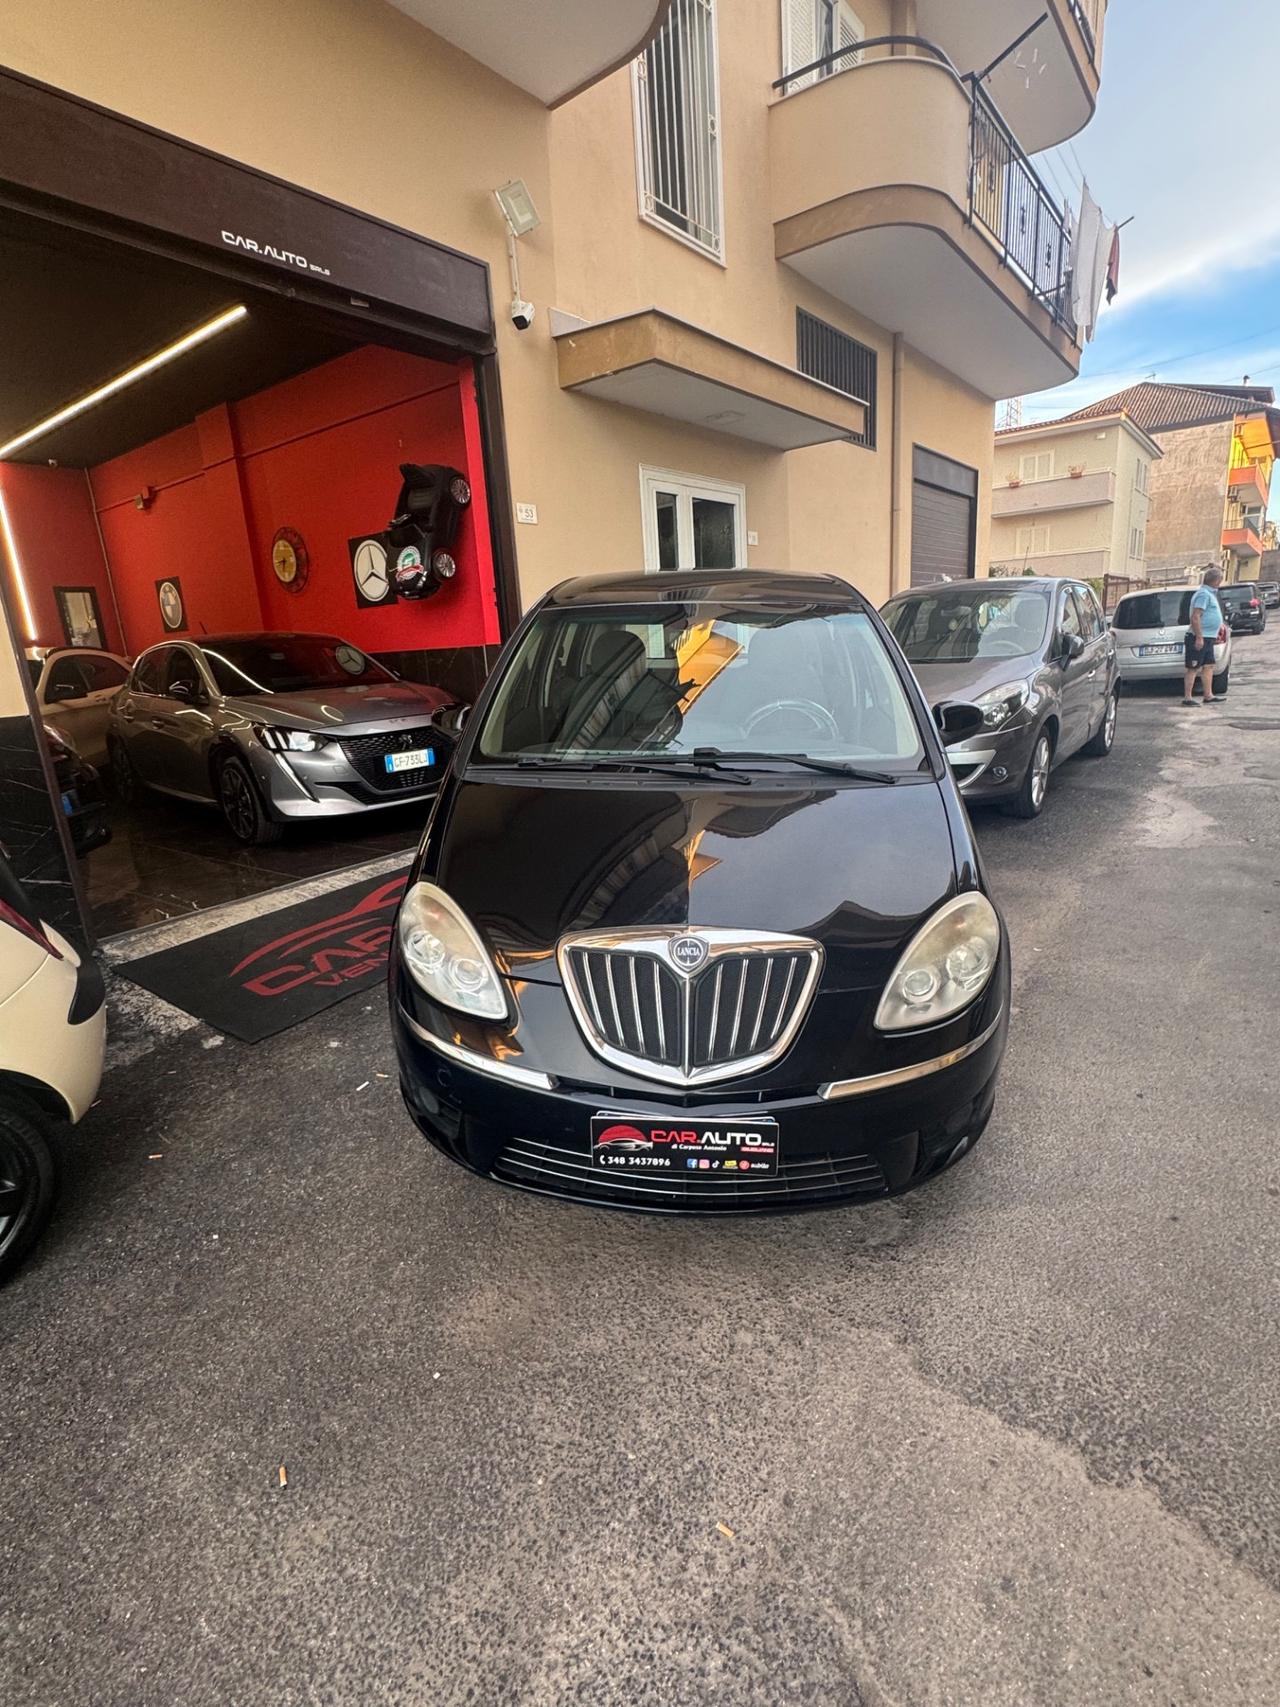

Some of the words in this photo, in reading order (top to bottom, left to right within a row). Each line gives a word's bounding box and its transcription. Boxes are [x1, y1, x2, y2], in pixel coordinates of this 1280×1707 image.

[677, 947, 701, 956] LANCIA
[608, 1157, 626, 1165] 348
[628, 1157, 671, 1167] 3437896
